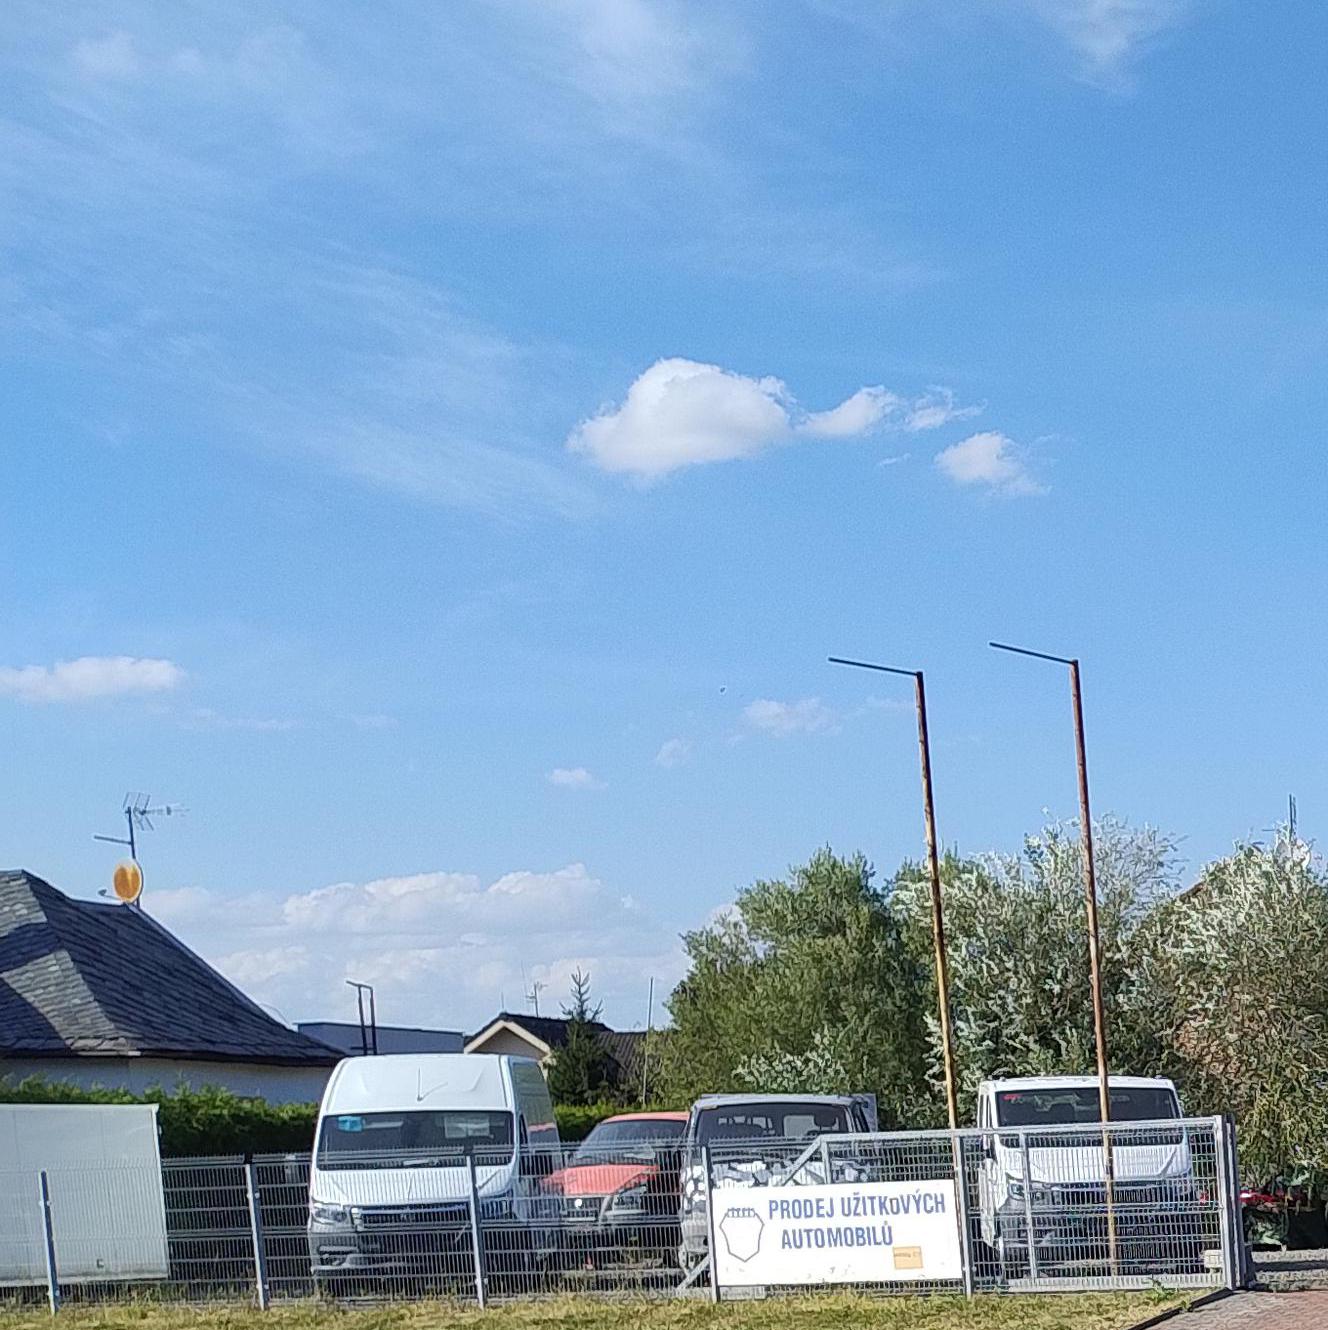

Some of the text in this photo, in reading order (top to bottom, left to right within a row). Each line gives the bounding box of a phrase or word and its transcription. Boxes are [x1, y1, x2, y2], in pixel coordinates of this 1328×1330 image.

[769, 1188, 946, 1220] PRODEJ UŽITKOVÝCH
[781, 1220, 893, 1250] AUTOMOBILŮ
